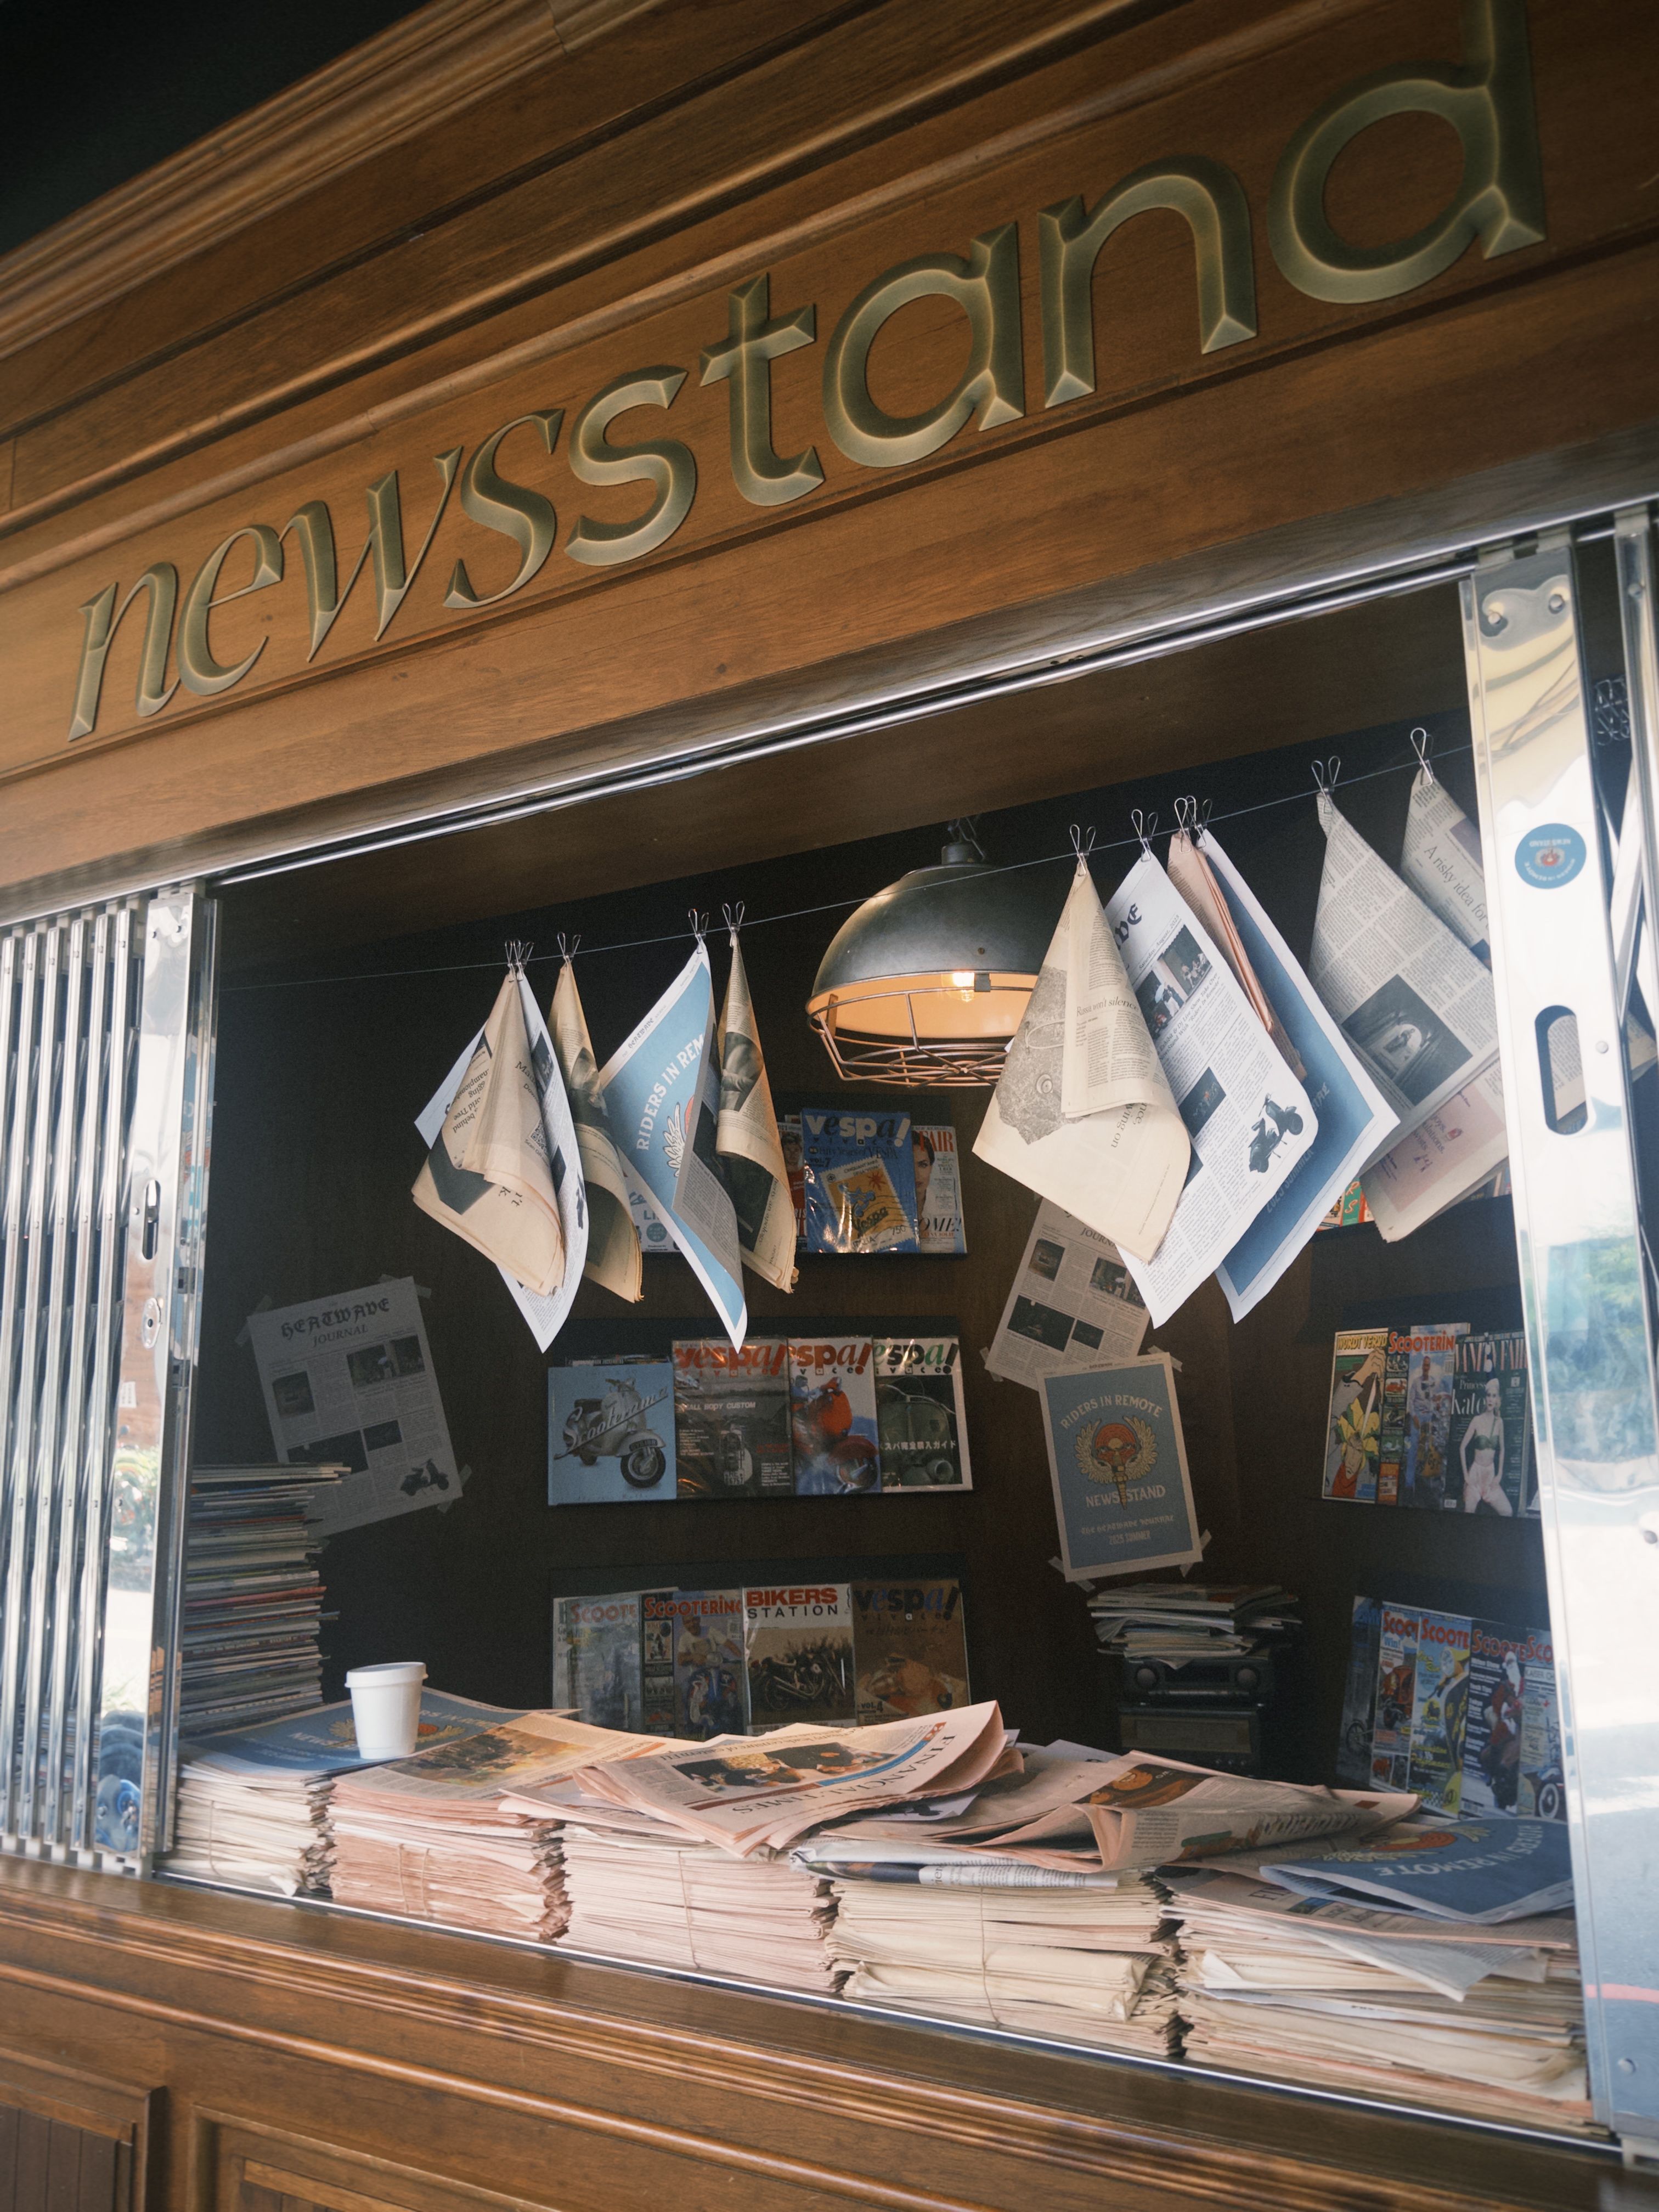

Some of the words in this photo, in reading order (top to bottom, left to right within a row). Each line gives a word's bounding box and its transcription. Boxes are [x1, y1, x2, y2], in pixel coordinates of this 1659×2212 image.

[67, 0, 1546, 742] newsstand
[1424, 846, 1438, 859] A
[1433, 857, 1456, 883] risky
[1454, 879, 1474, 907] idea
[1471, 904, 1487, 921] for
[1190, 1000, 1200, 1011] Show
[1209, 973, 1218, 986] Over
[453, 1106, 469, 1122] Tree
[636, 1082, 667, 1151] RIDERS
[662, 1062, 680, 1086] IN
[453, 1113, 476, 1133] behind
[805, 1114, 911, 1148] vespa!
[919, 1130, 955, 1153] FAIR
[313, 1325, 369, 1347] JOURNAL
[726, 1401, 756, 1409] CUSTOM
[1060, 1396, 1098, 1429] RIDERS
[1100, 1395, 1113, 1407] IN
[1115, 1395, 1163, 1418] REMOTE
[747, 1587, 838, 1607] BIKERS
[748, 1605, 838, 1620] STATION
[680, 1747, 725, 1758] eastern
[739, 1739, 783, 1751] censure
[831, 1734, 957, 1795] FINANCIAL
[733, 1789, 825, 1814] TIMES
[1507, 1824, 1544, 1854] RIDERS
[1374, 1854, 1499, 1877] REMOTE
